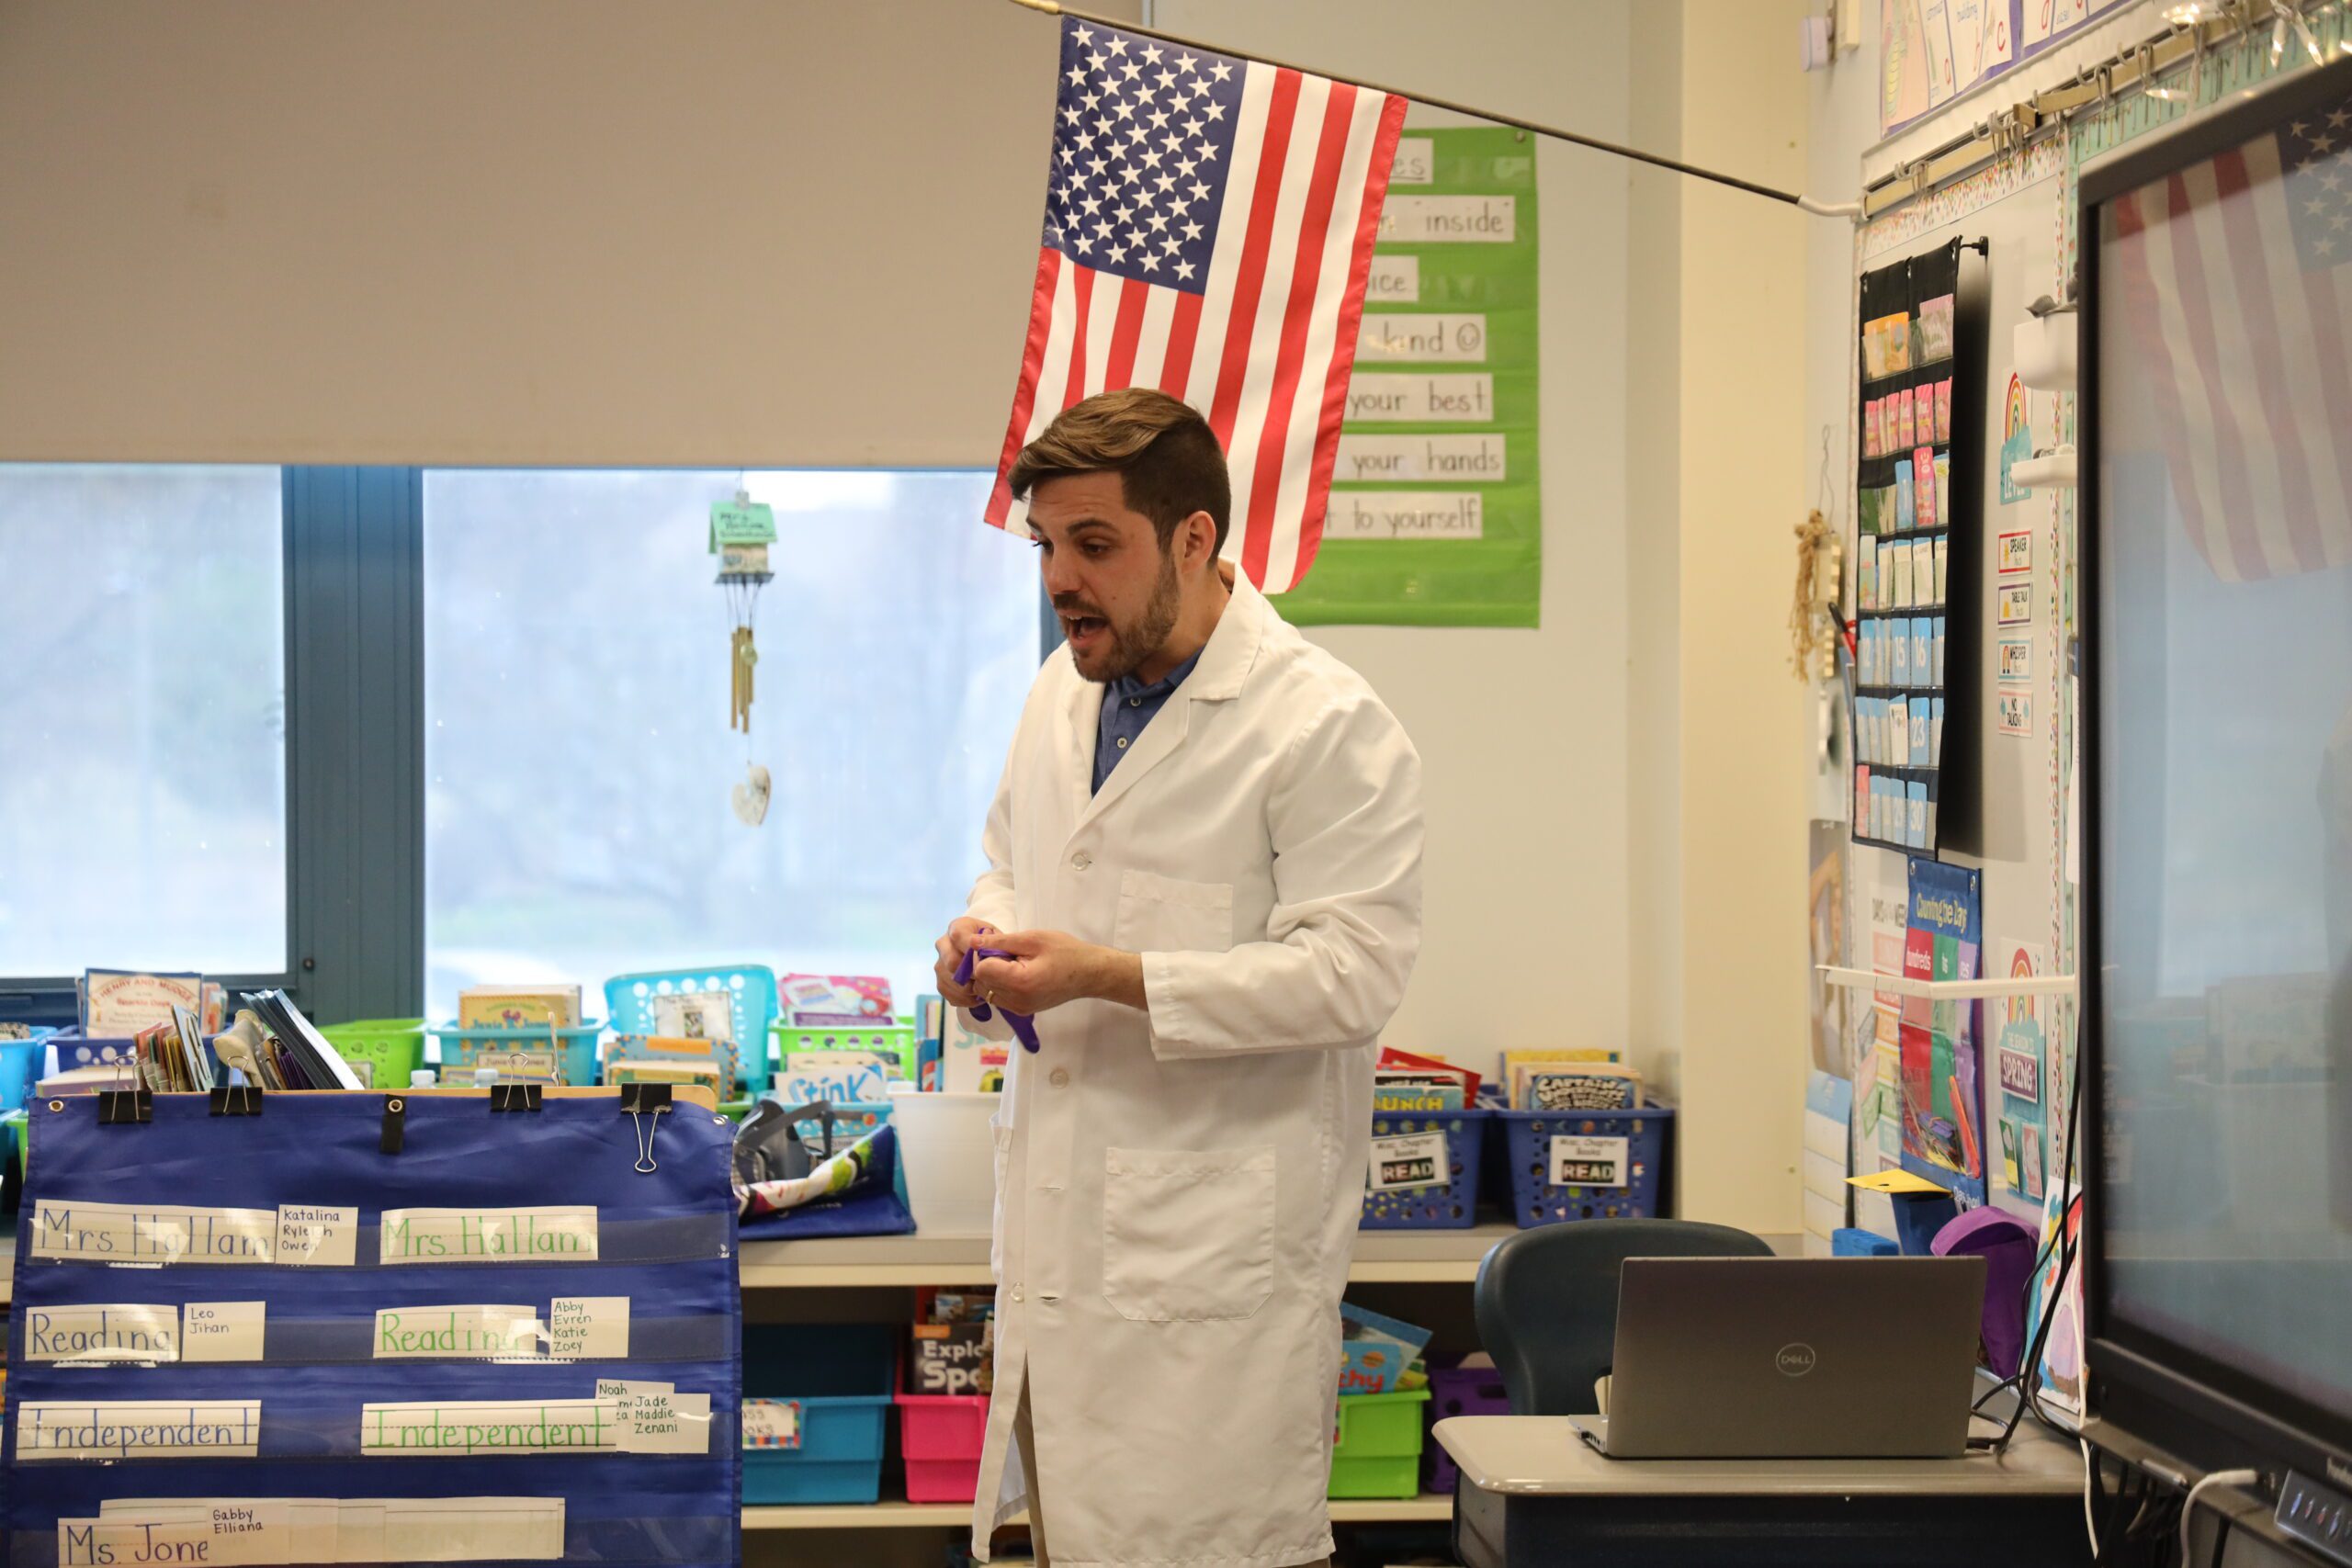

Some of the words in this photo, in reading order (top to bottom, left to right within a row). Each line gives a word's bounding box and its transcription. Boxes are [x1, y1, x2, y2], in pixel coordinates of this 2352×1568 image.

[1382, 321, 1445, 354] kind
[1349, 392, 1408, 419] your
[1429, 380, 1486, 412] best
[1351, 452, 1404, 479] your
[1427, 439, 1500, 472] hands
[1352, 500, 1374, 531] to
[2010, 536, 2028, 553] SPEAKER
[1894, 636, 1905, 668] 15
[1914, 636, 1927, 668] 16
[2009, 645, 2027, 660] WHISPER
[2011, 697, 2018, 712] NO
[1911, 716, 1926, 749] 23
[1910, 799, 1924, 832] 30
[2003, 1055, 2033, 1092] SPRING
[1382, 1161, 1434, 1182] READ
[1562, 1162, 1614, 1181] READ
[282, 1208, 341, 1223] Katalina
[132, 1213, 269, 1258] Hallam
[384, 1217, 455, 1258] Mrs.
[460, 1214, 594, 1257] Hallam
[190, 1307, 215, 1321] Leo
[554, 1301, 584, 1315] Abby
[188, 1321, 230, 1335] Jihan
[553, 1314, 592, 1325] Evren
[553, 1325, 589, 1339] Katie
[553, 1340, 583, 1355] Zoey
[1781, 1354, 1811, 1365] DELL
[598, 1382, 628, 1395] Noah
[634, 1395, 669, 1407] Jade
[635, 1407, 675, 1420] Maddie
[30, 1406, 253, 1457] Independent
[366, 1404, 612, 1454] Independent
[634, 1419, 678, 1434] Zenani
[211, 1508, 254, 1523] Gabby
[213, 1520, 264, 1535] Elliana
[65, 1524, 122, 1566] Ms.
